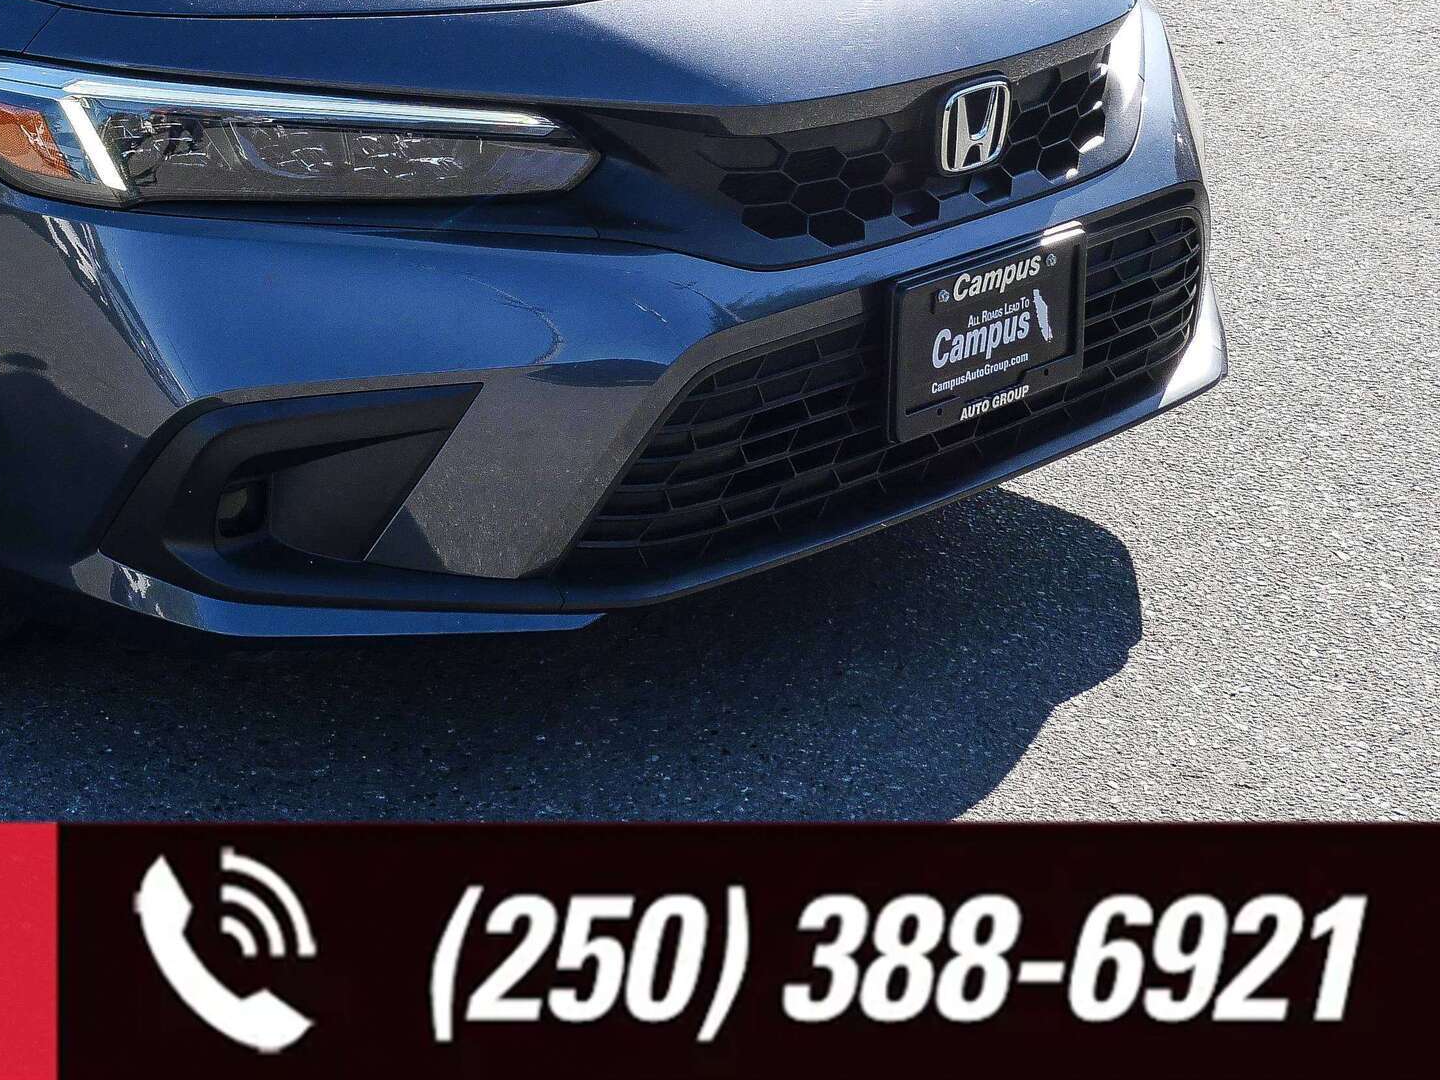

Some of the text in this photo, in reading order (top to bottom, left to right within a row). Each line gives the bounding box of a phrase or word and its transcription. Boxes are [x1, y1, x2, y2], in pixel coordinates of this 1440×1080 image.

[953, 255, 1042, 302] Campus
[932, 311, 1031, 369] Campus
[931, 353, 1029, 394] CampusAutoGroup.com
[960, 385, 1030, 421] AUTO GROUP
